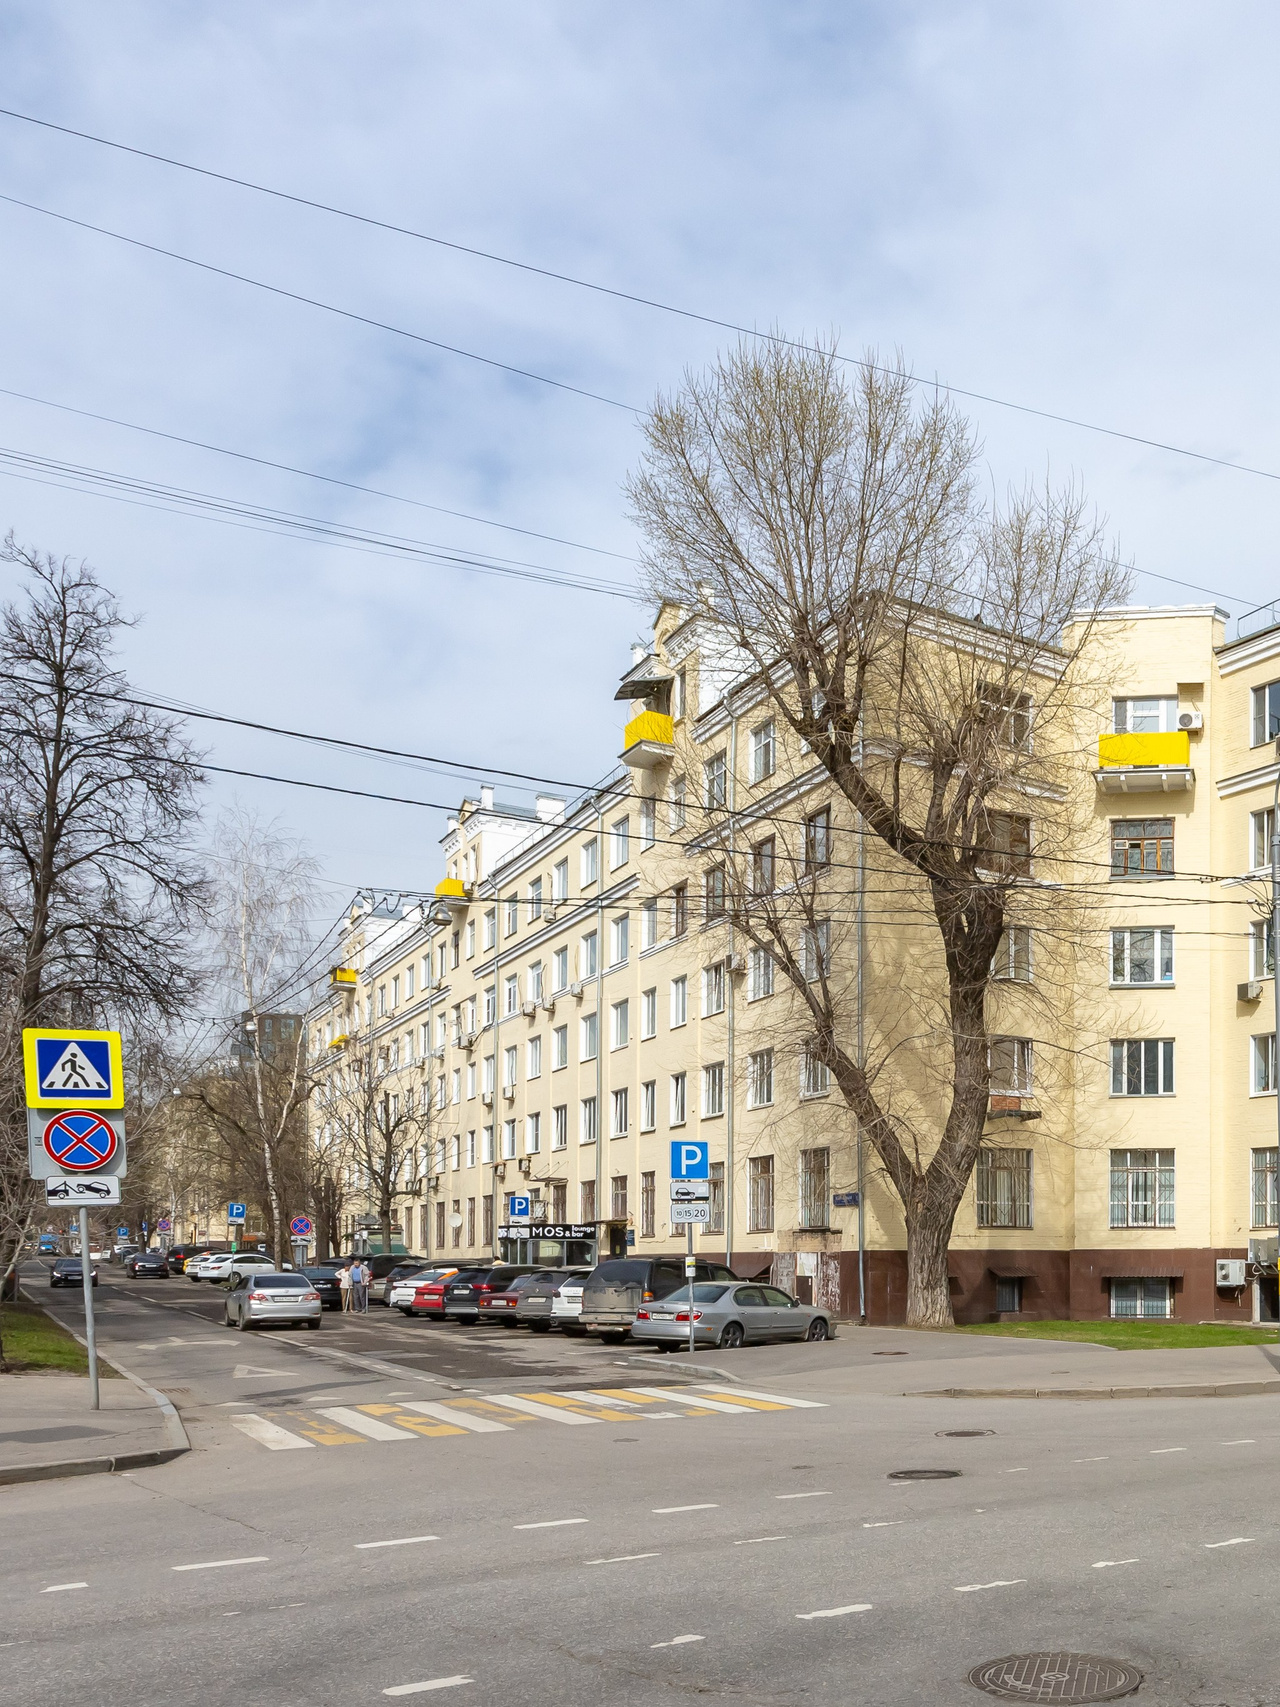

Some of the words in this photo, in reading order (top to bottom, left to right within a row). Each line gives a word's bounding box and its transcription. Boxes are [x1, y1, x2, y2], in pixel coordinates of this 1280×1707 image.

[681, 1145, 702, 1175] P
[515, 1199, 526, 1214] P
[694, 1209, 705, 1218] 20
[532, 1227, 564, 1237] MOS
[572, 1225, 595, 1233] lounge
